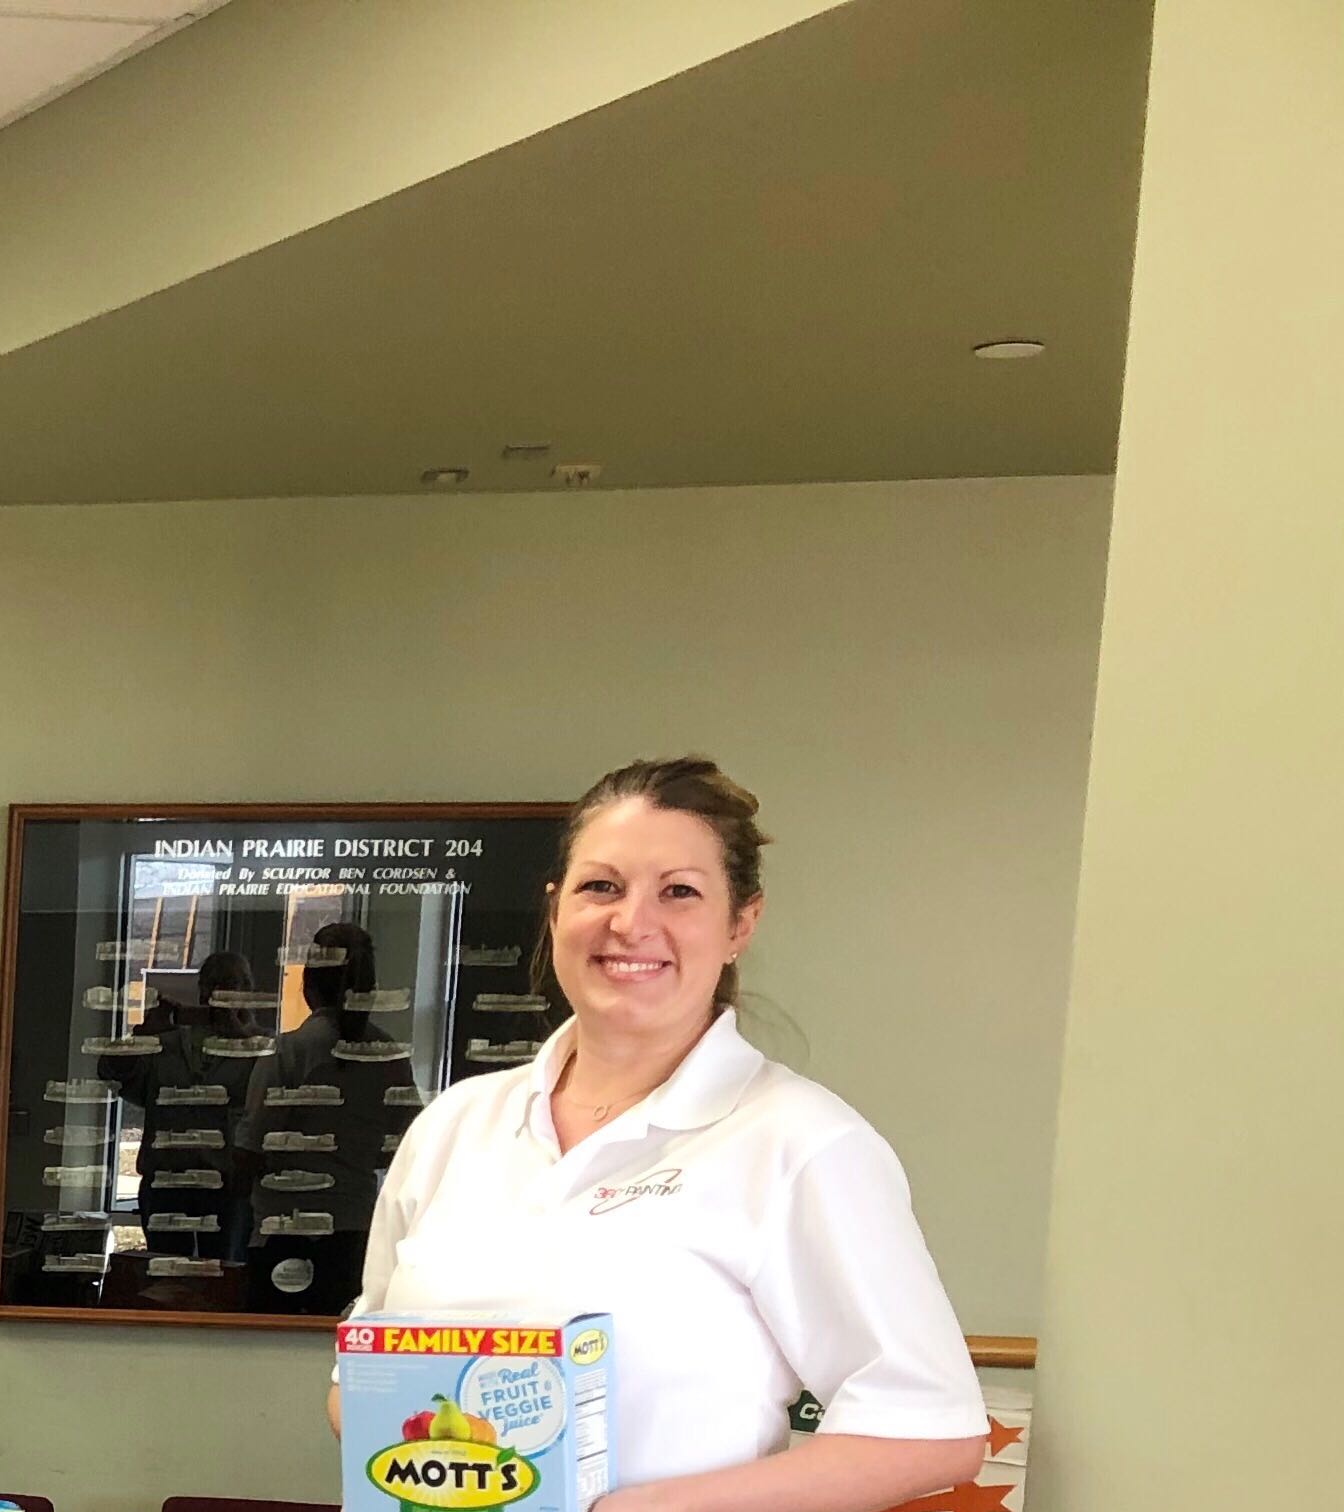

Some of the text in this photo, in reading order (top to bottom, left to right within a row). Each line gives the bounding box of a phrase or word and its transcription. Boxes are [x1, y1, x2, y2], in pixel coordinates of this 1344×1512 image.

[153, 839, 484, 858] INDIAN PRAIRIE DISTRICT 204
[238, 867, 255, 883] By
[261, 867, 332, 880] SCULPTOR
[338, 867, 367, 879] BEN
[372, 867, 438, 879] CORDSEN
[444, 867, 457, 879] &
[218, 882, 271, 896] PRAIRIE
[275, 882, 371, 895] EDUCATIONAL
[378, 881, 473, 895] FOUNDATION
[345, 1328, 375, 1345] 40
[383, 1327, 557, 1354] FAMILY SIZE
[498, 1362, 539, 1385] Real
[480, 1381, 538, 1405] FRUIT
[477, 1396, 553, 1421] VEGGIE
[500, 1413, 543, 1437] juice
[384, 1457, 519, 1491] MOTT'S
